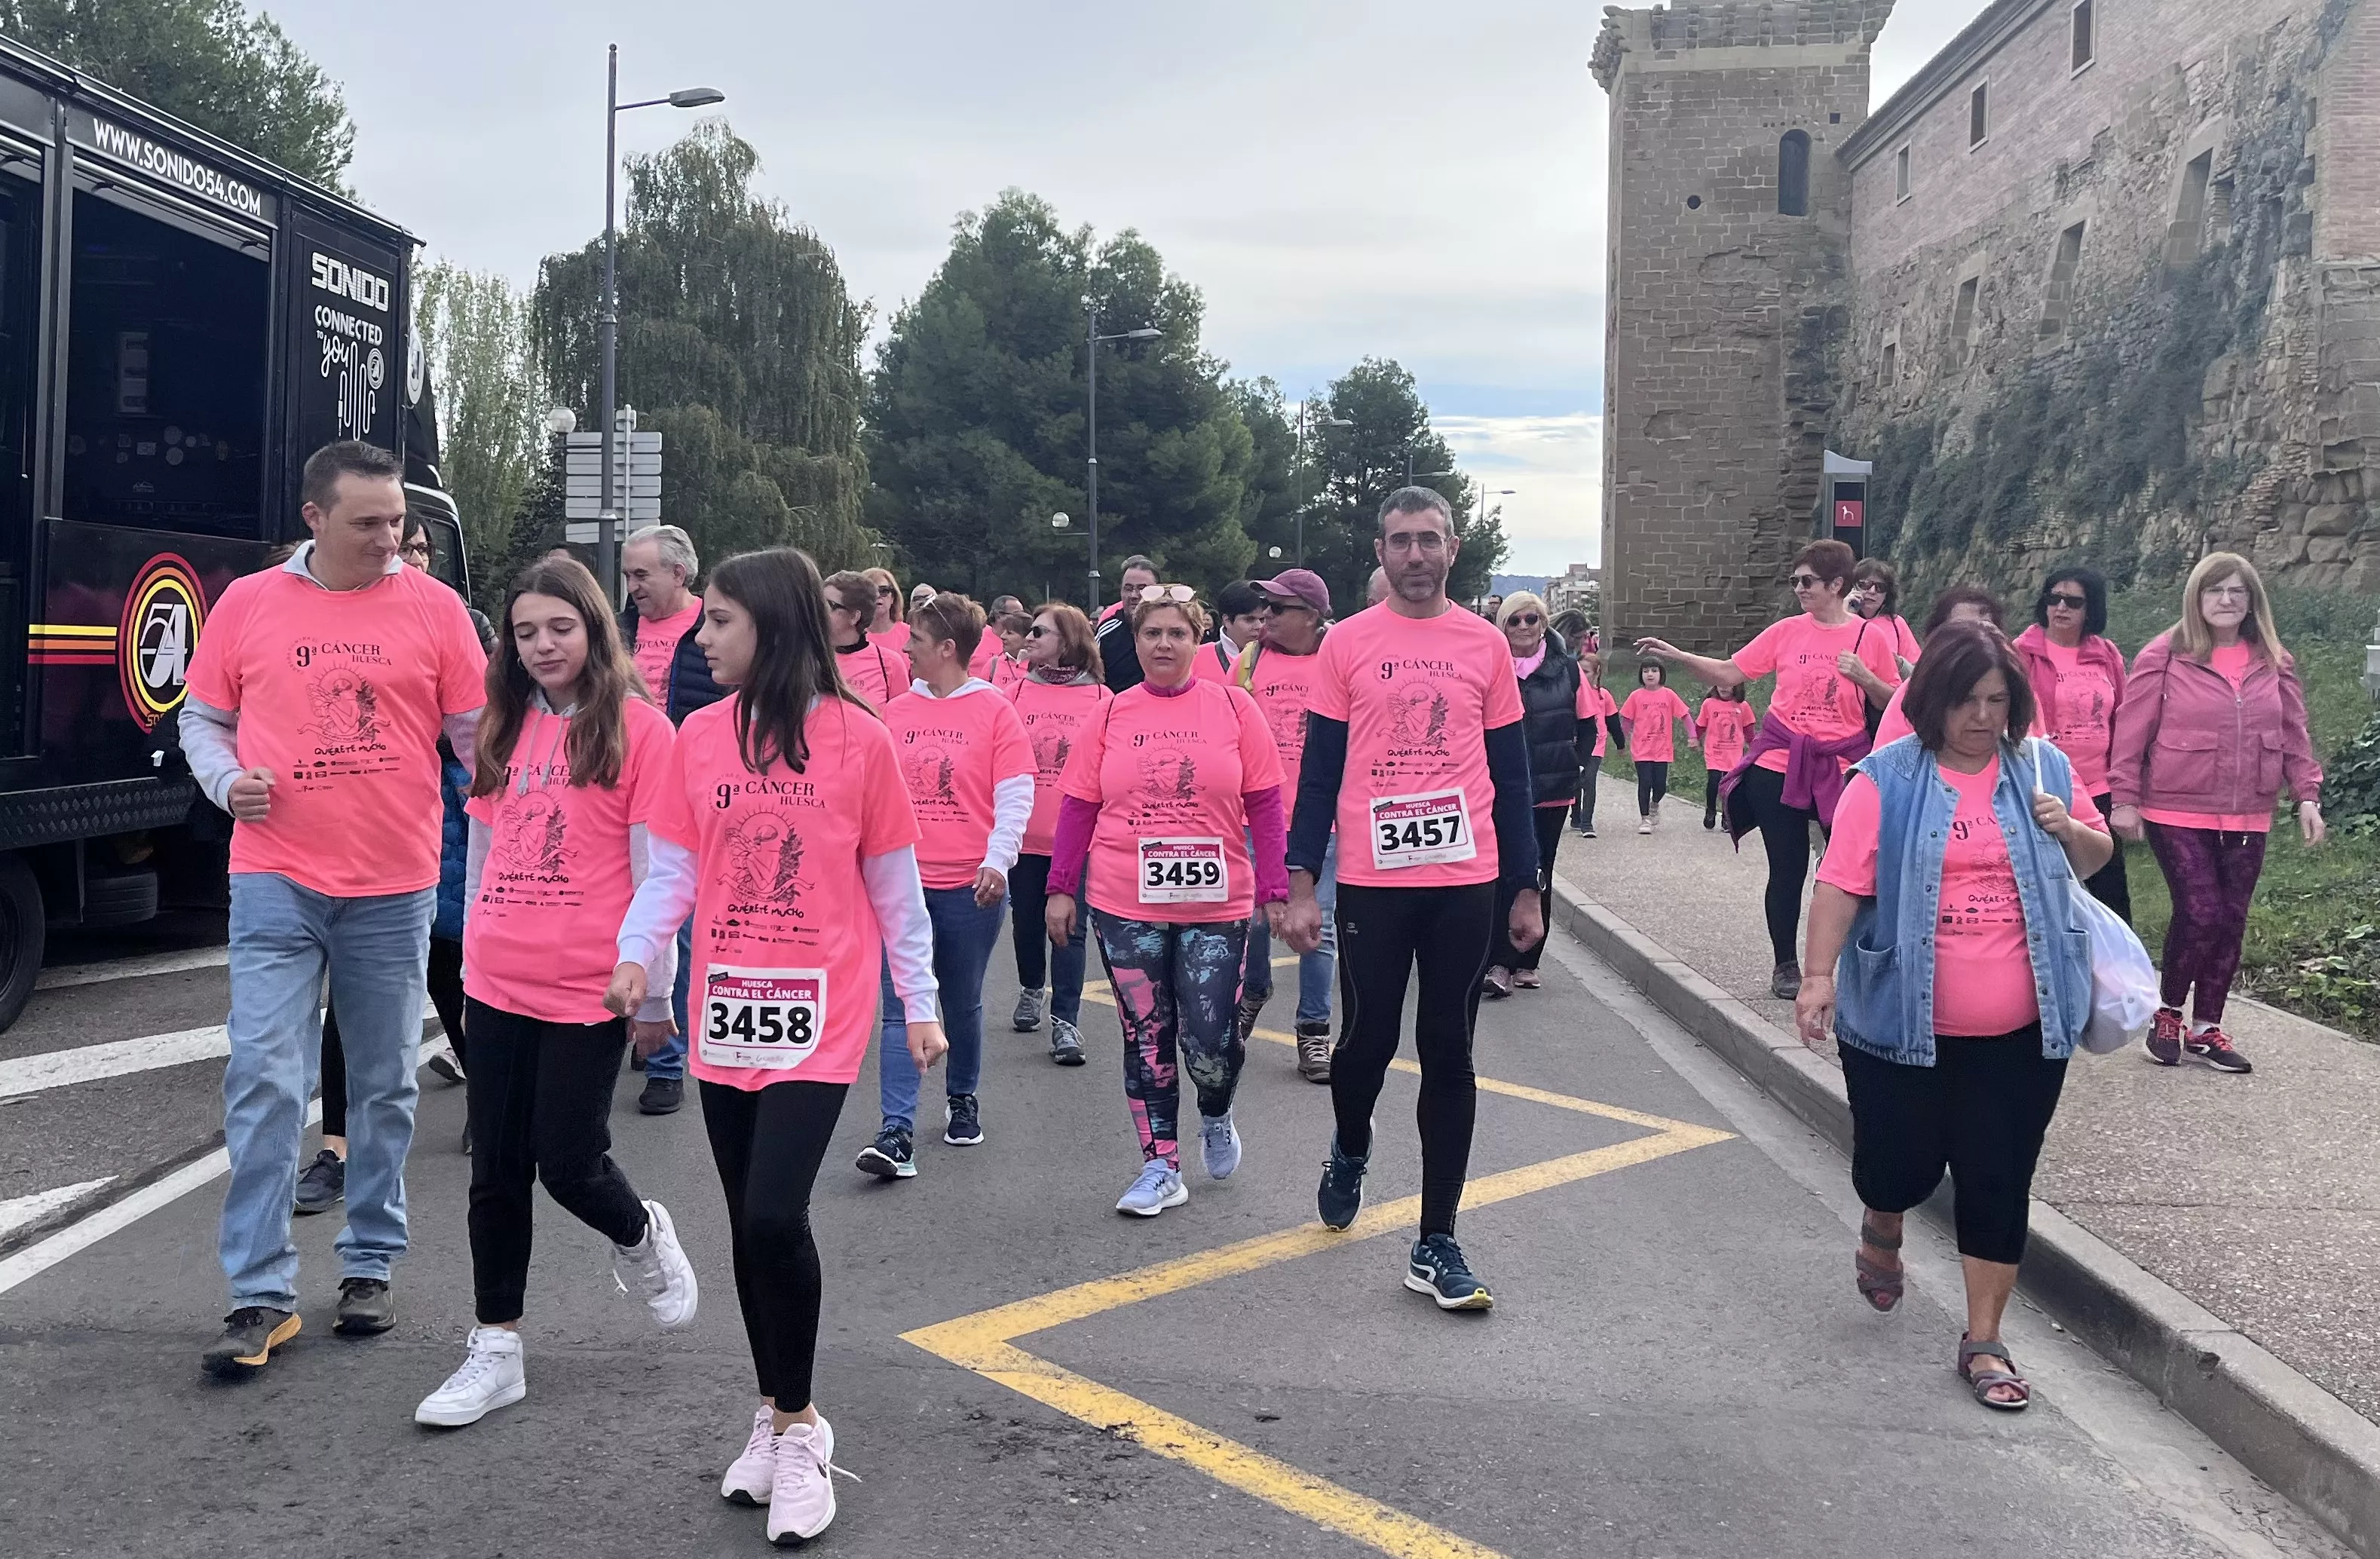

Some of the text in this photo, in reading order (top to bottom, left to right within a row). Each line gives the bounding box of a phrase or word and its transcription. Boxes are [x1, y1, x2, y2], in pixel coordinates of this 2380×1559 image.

[93, 118, 261, 216] WWW.SONIDO54.COM
[311, 252, 389, 312] SONIDO
[314, 305, 383, 346] CONNECTED
[317, 330, 323, 338] TO
[321, 335, 350, 377] you
[322, 642, 380, 656] CÁNCER
[352, 654, 392, 666] HUESCA
[1403, 658, 1453, 671] CÁNCER
[1429, 670, 1463, 680] HUESCA
[924, 727, 963, 739] CÁNCER
[1153, 730, 1198, 739] CÁNCER
[359, 743, 386, 752] MUCHO
[716, 784, 740, 809] 9ª
[746, 778, 814, 796] CÁNCER
[780, 796, 825, 809] HUESCA
[1379, 803, 1457, 819] CONTRA EL CÁNCER
[1380, 815, 1460, 851] 3457
[1190, 850, 1216, 858] CÁNCER
[538, 874, 569, 884] MUCHO
[1147, 862, 1220, 886] 3459
[771, 908, 804, 918] MUCHO
[741, 980, 773, 988] HUESCA
[712, 985, 812, 1000] CONTRA EL CÁNCER
[709, 1003, 812, 1044] 3458
